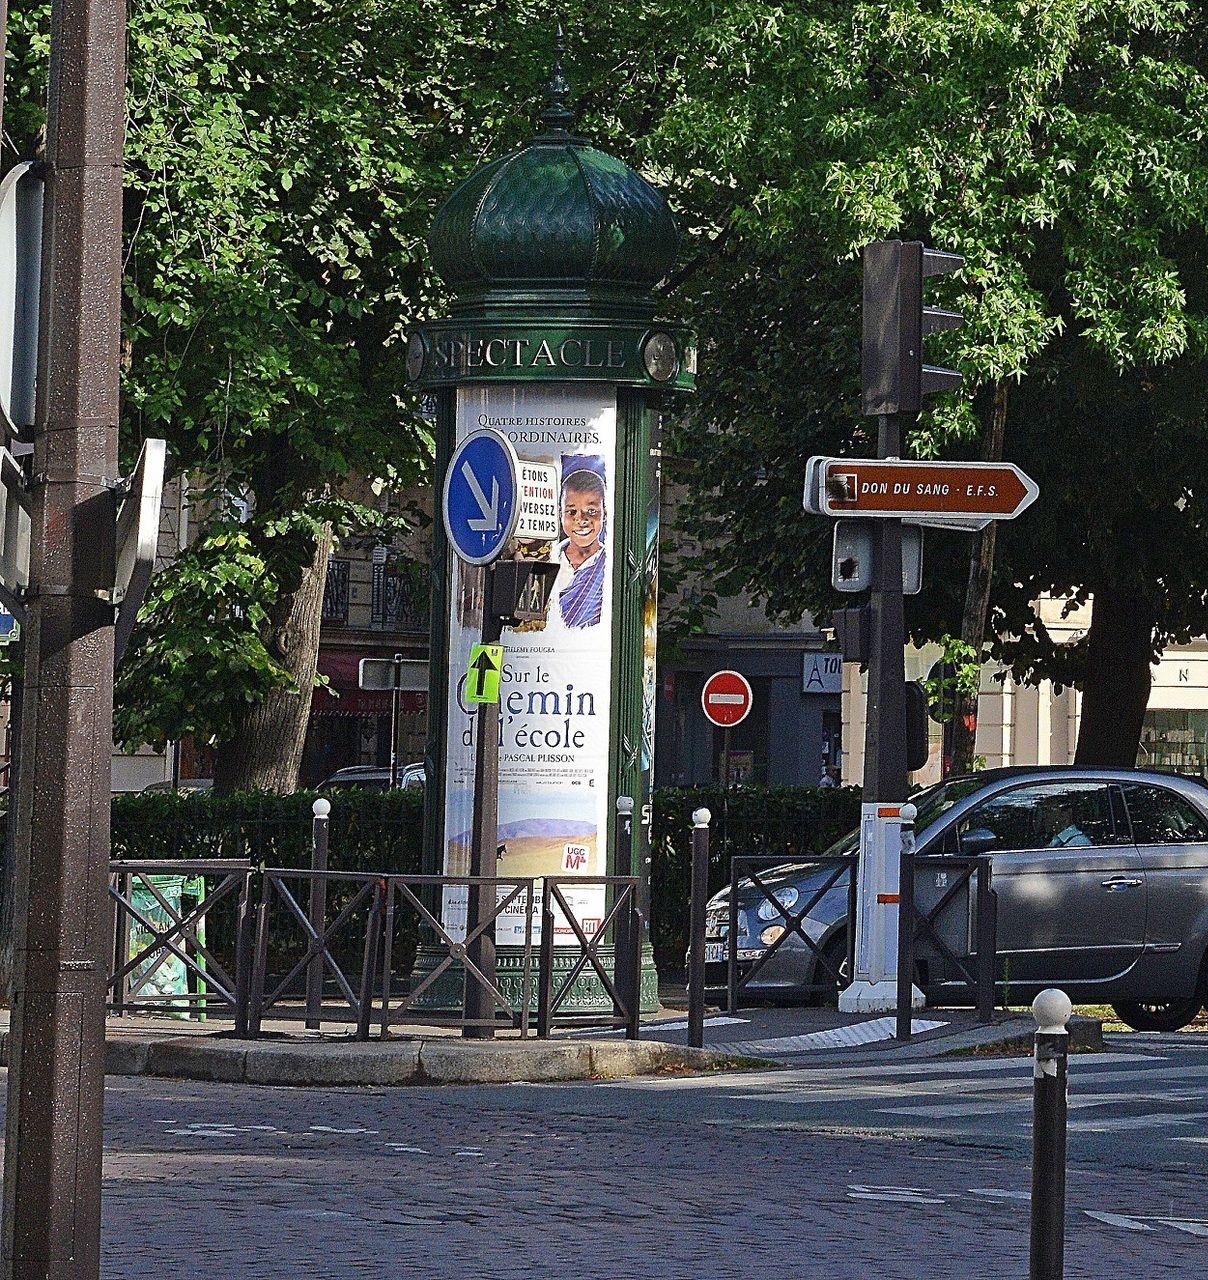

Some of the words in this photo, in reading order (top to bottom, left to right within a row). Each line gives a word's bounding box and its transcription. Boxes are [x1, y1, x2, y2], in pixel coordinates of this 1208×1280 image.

[435, 339, 626, 368] SPECTACLE
[525, 415, 587, 427] HISTOIRES
[522, 467, 548, 483] ÉTONS
[521, 485, 554, 500] ENTION
[861, 482, 888, 494] DON
[893, 483, 911, 494] DU
[916, 483, 950, 495] SANG
[966, 485, 999, 497] E.F.S.
[520, 501, 556, 517] VERSEZ
[519, 518, 525, 530] 2
[528, 519, 556, 532] TEMPS
[501, 663, 531, 683] Sur
[536, 665, 550, 683] le
[456, 672, 596, 716] Cemin
[504, 754, 536, 763] PASCAL
[537, 754, 575, 763] PLISSON
[567, 846, 585, 856] UGC
[505, 904, 539, 915] CINÉA
